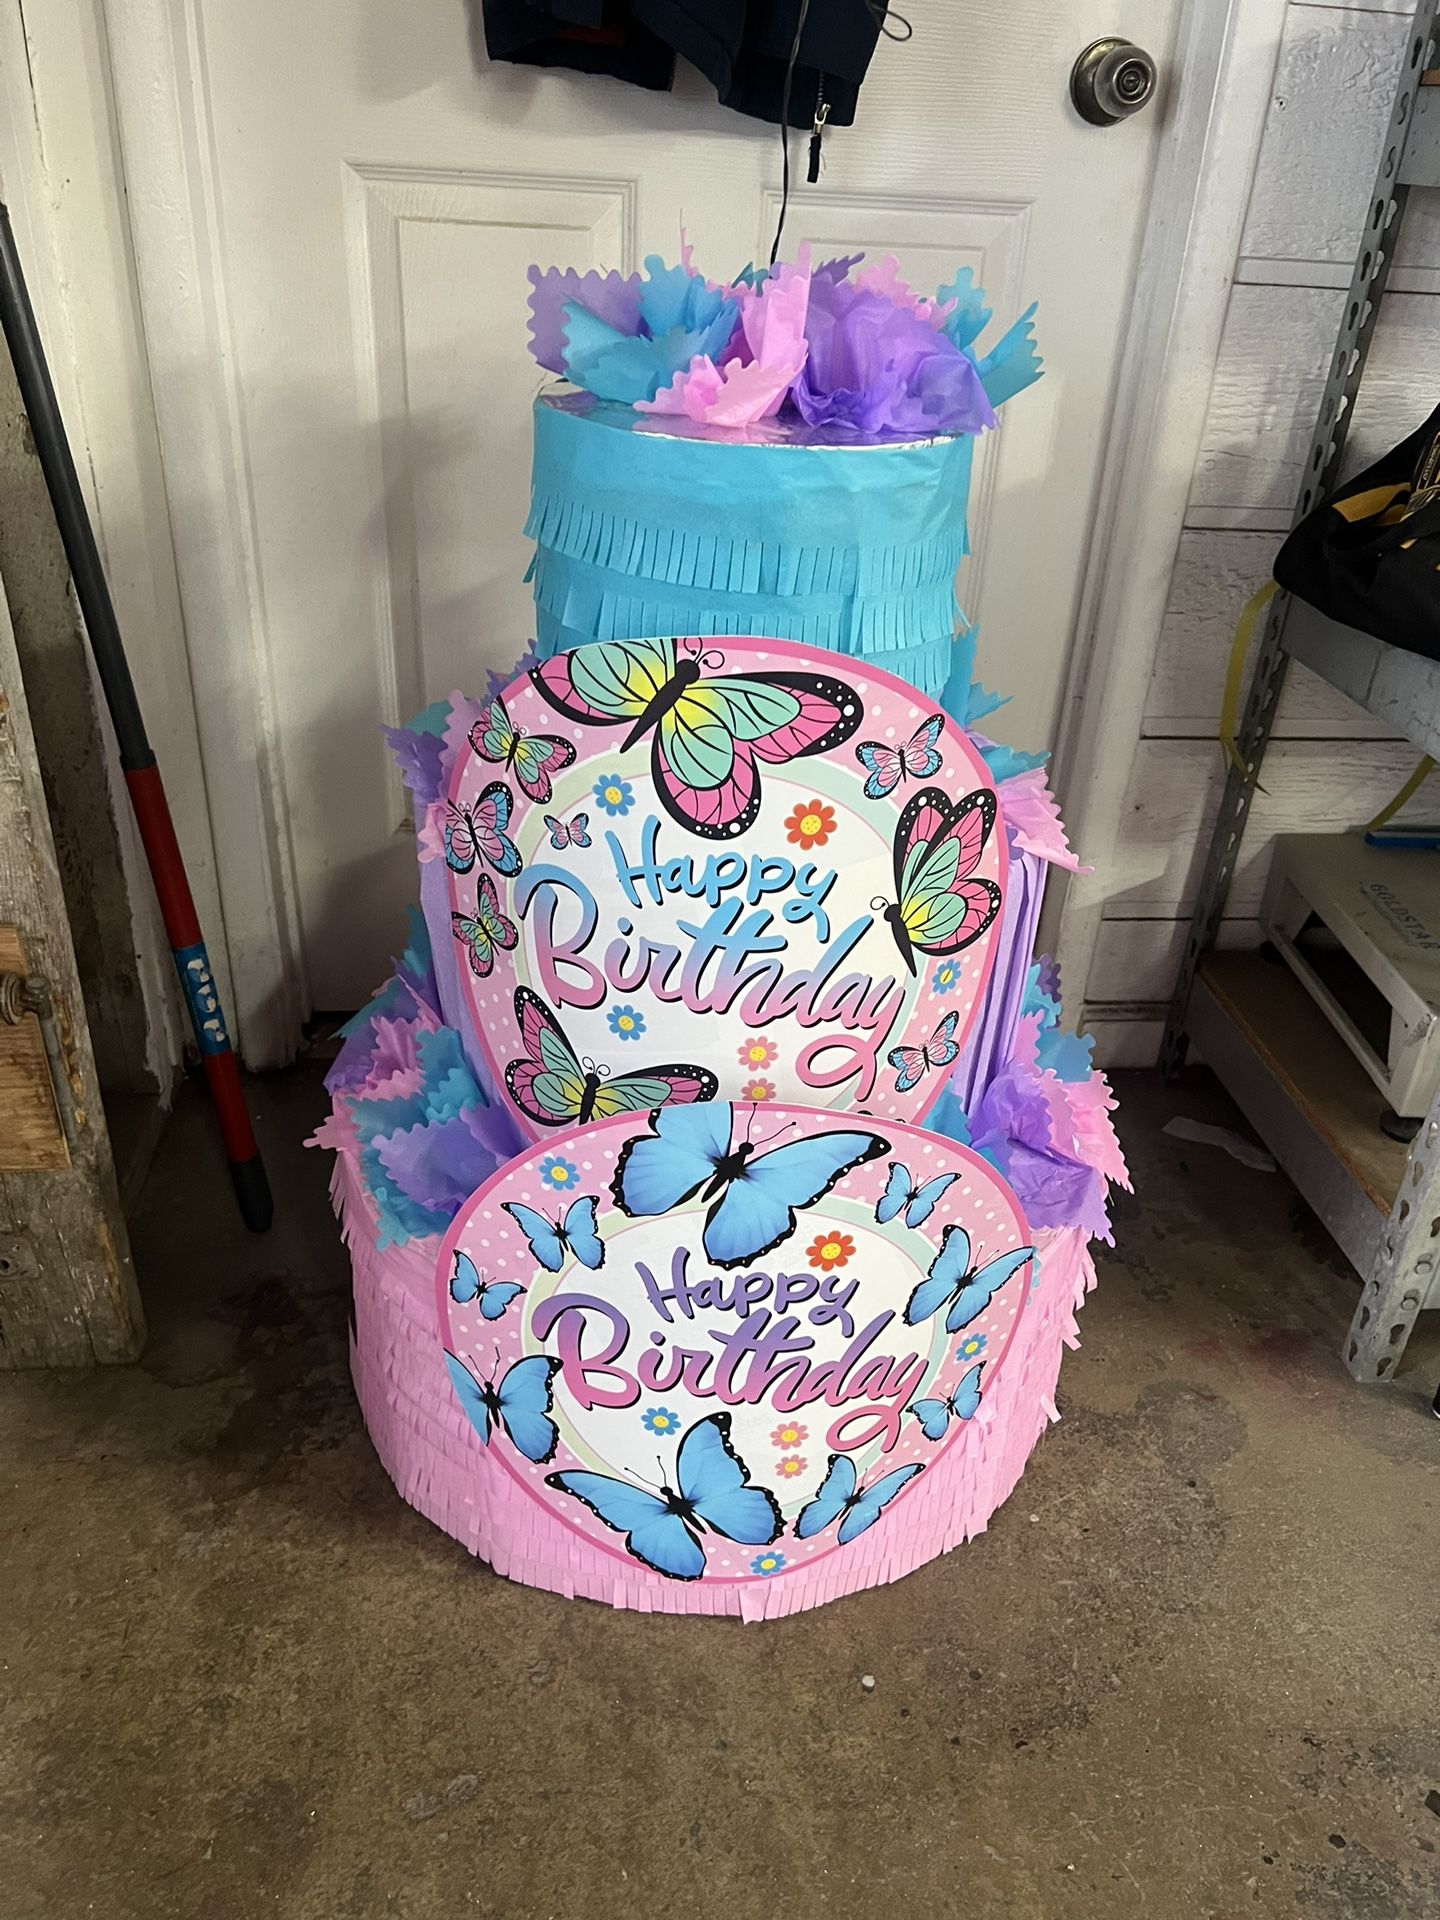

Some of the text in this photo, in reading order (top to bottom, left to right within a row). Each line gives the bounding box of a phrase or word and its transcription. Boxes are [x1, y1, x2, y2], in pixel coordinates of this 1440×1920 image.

[605, 815, 838, 943] Happy
[514, 863, 905, 1102] Birthday
[634, 1246, 860, 1338] Happy
[531, 1292, 929, 1453] Birthday
